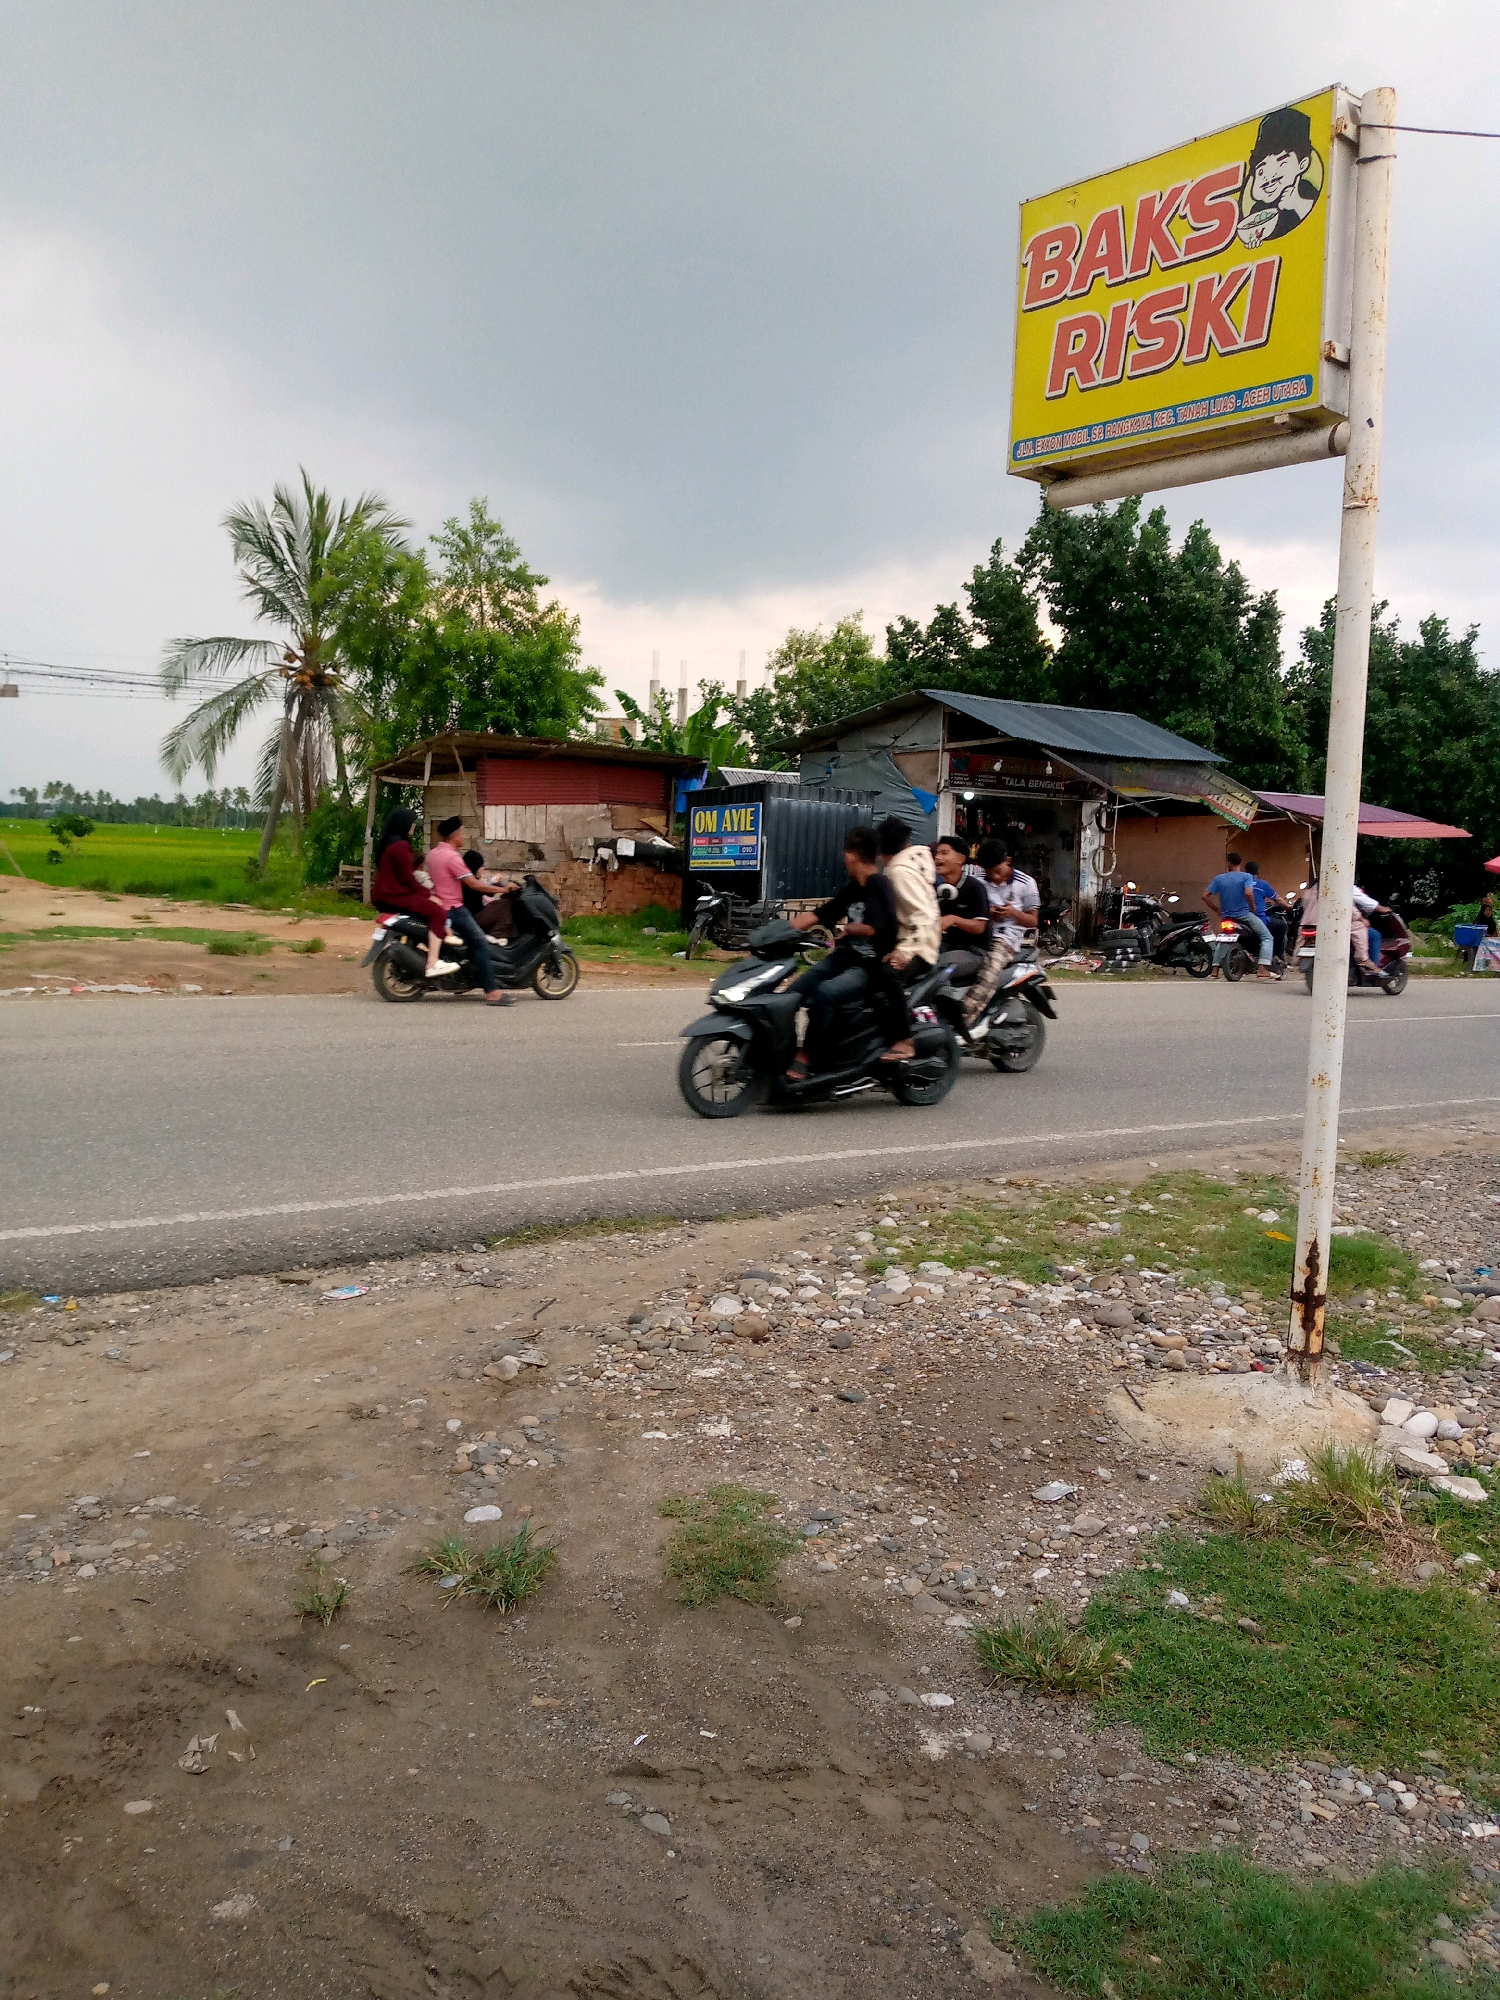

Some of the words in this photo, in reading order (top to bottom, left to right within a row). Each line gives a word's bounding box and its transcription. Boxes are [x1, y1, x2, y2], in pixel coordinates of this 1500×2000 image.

[1046, 255, 1282, 399] RISKI
[1016, 442, 1034, 458] JLN.
[1035, 434, 1062, 454] EXXON
[1063, 428, 1090, 449] MOBIL
[1105, 414, 1153, 439] RANGKAYA
[1154, 410, 1175, 428] KEC.
[1176, 401, 1209, 422] TANAH
[1210, 395, 1235, 415] LUAS
[1242, 386, 1271, 408] ACEH
[1272, 378, 1307, 406] UTARA
[695, 811, 717, 833] OM
[722, 808, 755, 832] AYIE
